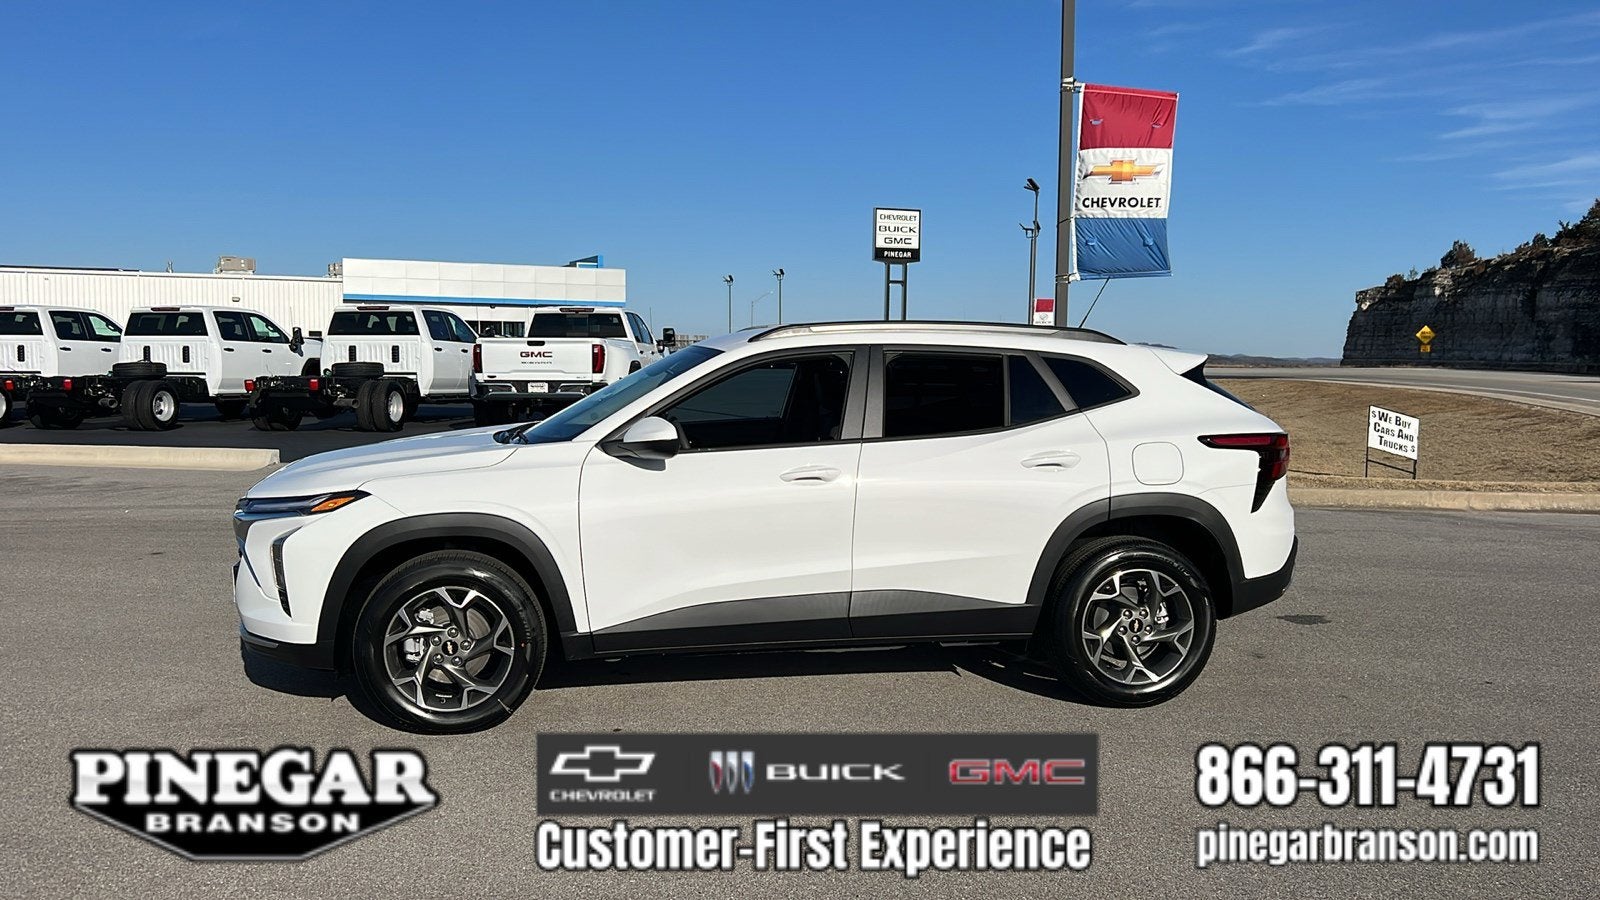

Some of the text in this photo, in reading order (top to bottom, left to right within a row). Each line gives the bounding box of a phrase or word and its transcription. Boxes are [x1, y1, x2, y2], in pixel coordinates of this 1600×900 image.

[1082, 197, 1162, 208] CHEVROLET
[878, 225, 917, 233] BUICK
[884, 237, 912, 245] GMC
